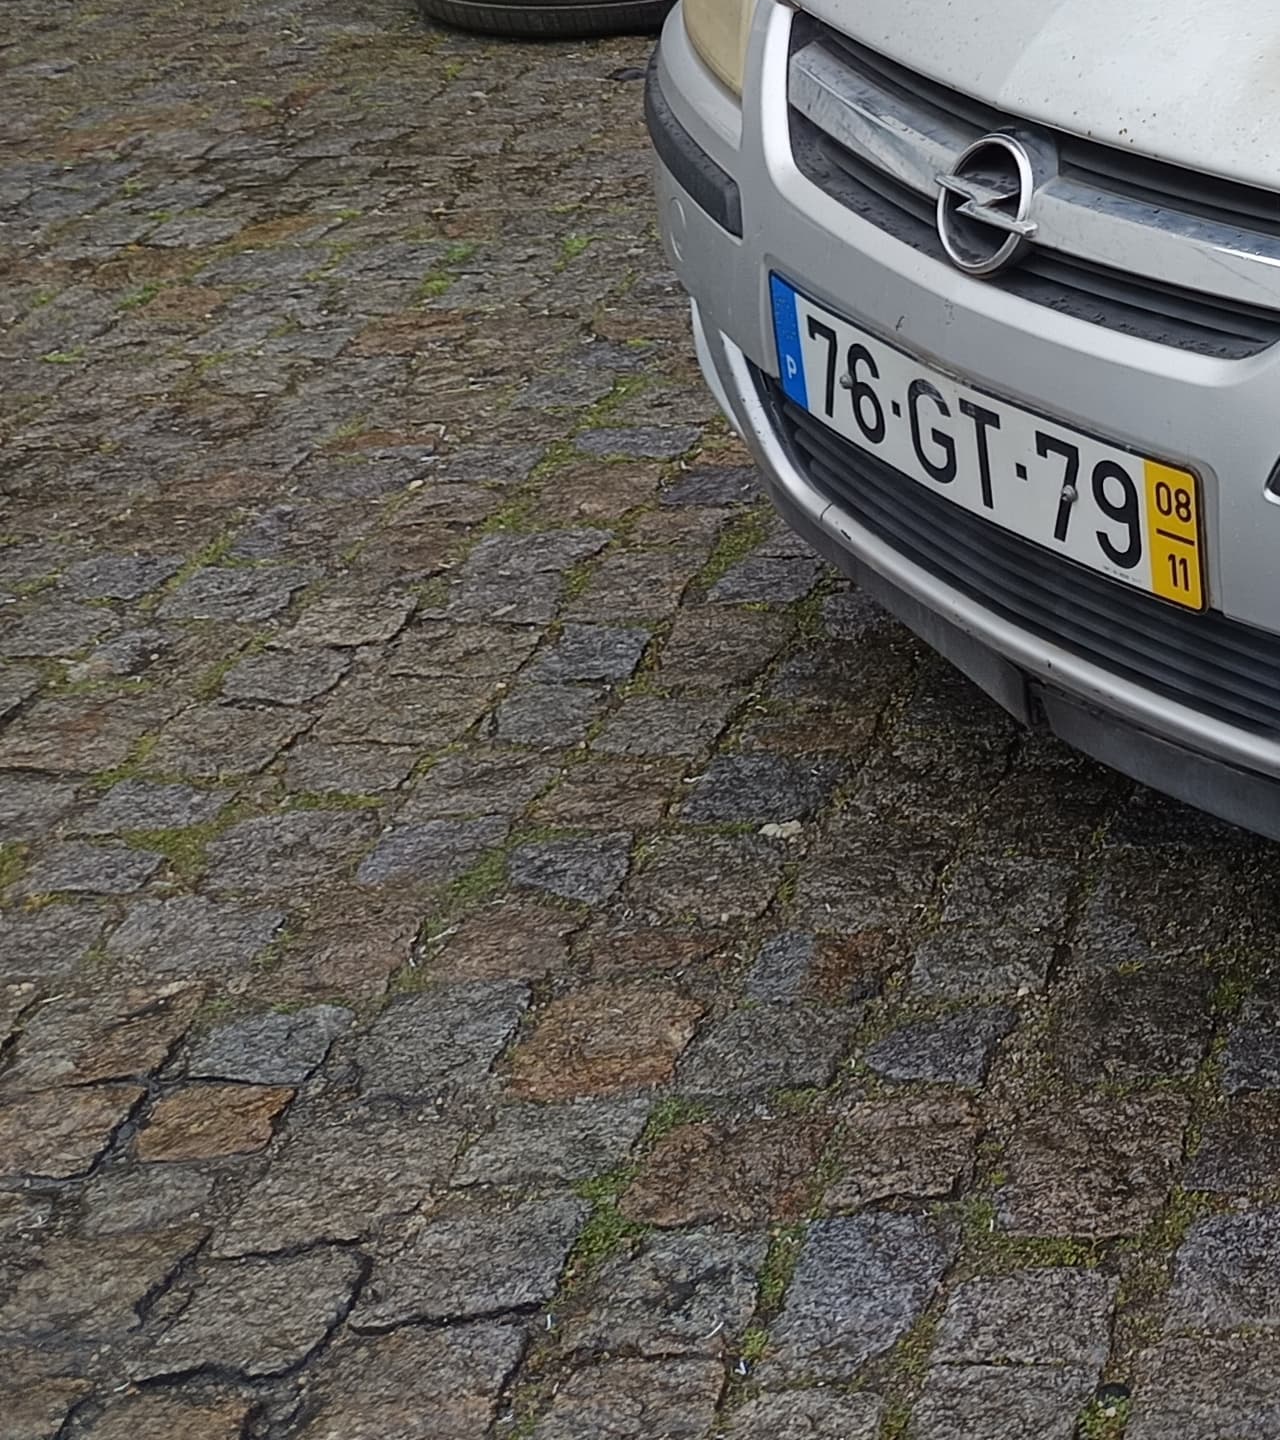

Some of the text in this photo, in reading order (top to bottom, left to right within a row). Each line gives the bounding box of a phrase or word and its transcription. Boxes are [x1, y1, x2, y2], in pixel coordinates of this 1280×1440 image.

[785, 353, 798, 379] P
[1154, 480, 1193, 524] 08
[1167, 552, 1191, 592] 11
